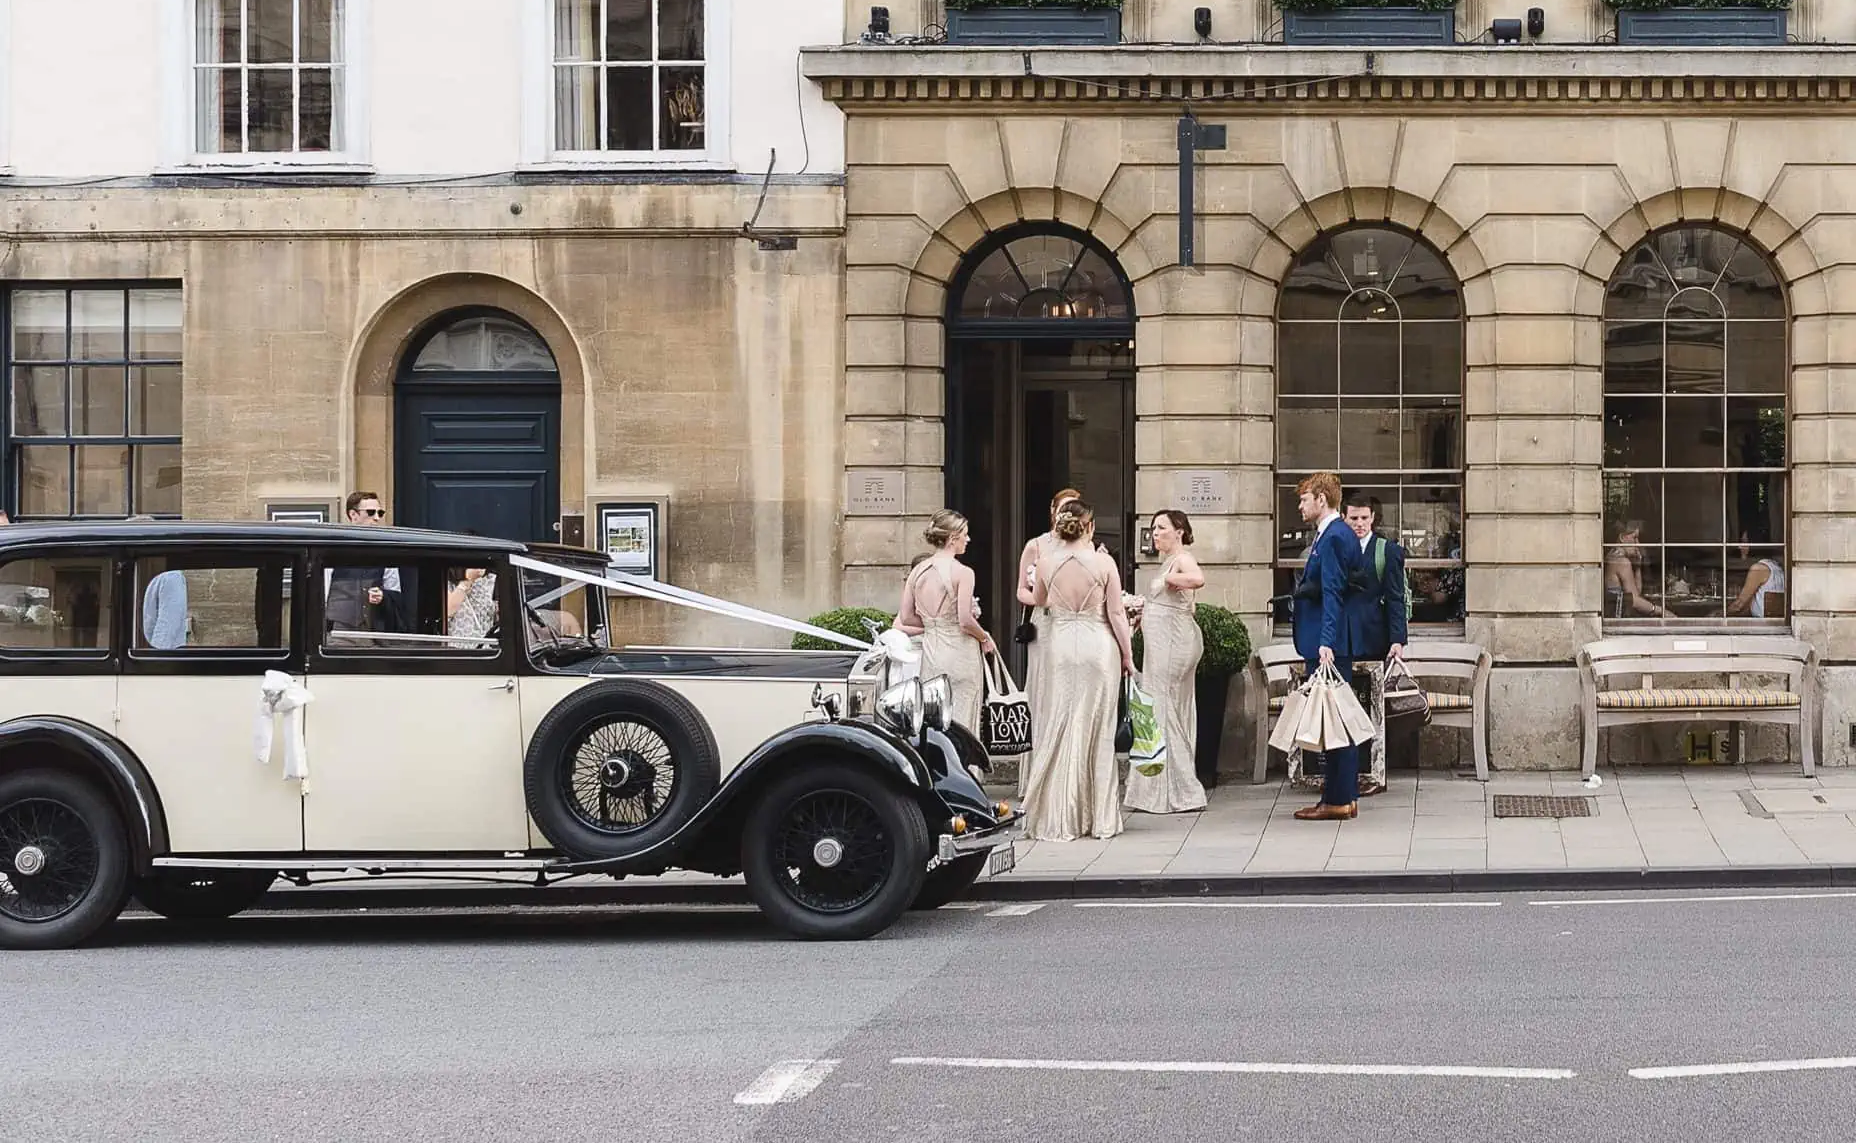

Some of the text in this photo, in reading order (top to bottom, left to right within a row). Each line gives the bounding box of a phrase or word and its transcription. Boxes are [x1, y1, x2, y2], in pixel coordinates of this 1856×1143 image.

[989, 704, 1030, 723] MAR
[989, 721, 1030, 743] LOW
[1691, 733, 1712, 760] H
